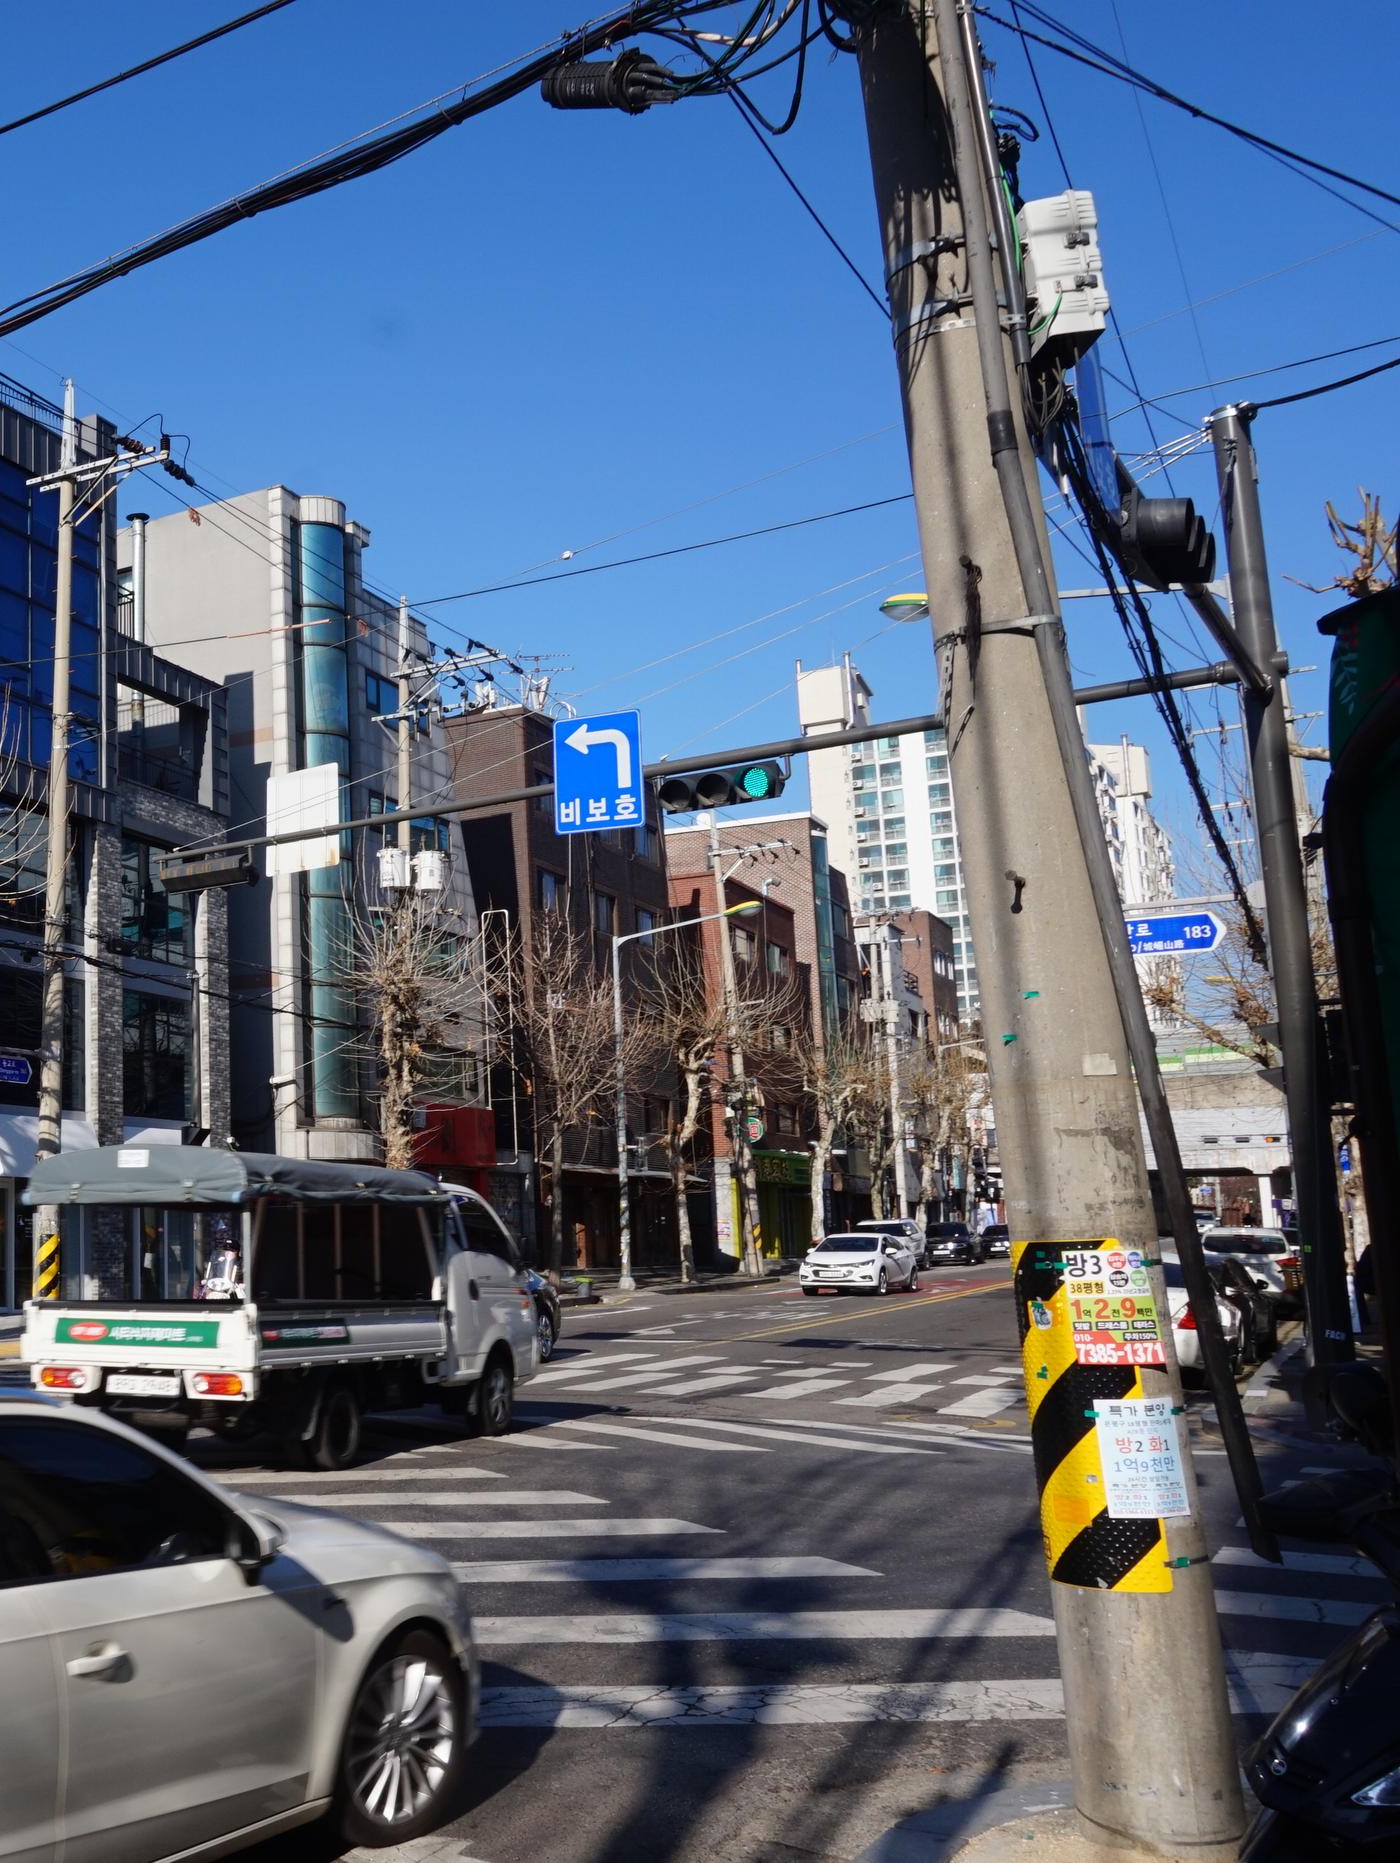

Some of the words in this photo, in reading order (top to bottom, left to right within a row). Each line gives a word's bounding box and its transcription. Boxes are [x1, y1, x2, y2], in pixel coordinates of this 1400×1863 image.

[560, 793, 639, 826] 비보호
[1183, 924, 1212, 939] 183
[1065, 1253, 1102, 1278] 방3
[1070, 1282, 1104, 1295] 38평형
[1074, 1333, 1094, 1342] 010-
[1076, 1342, 1166, 1364] 7385-1371
[1144, 1403, 1166, 1417] 분양
[1113, 1455, 1175, 1474] 1억9천만
